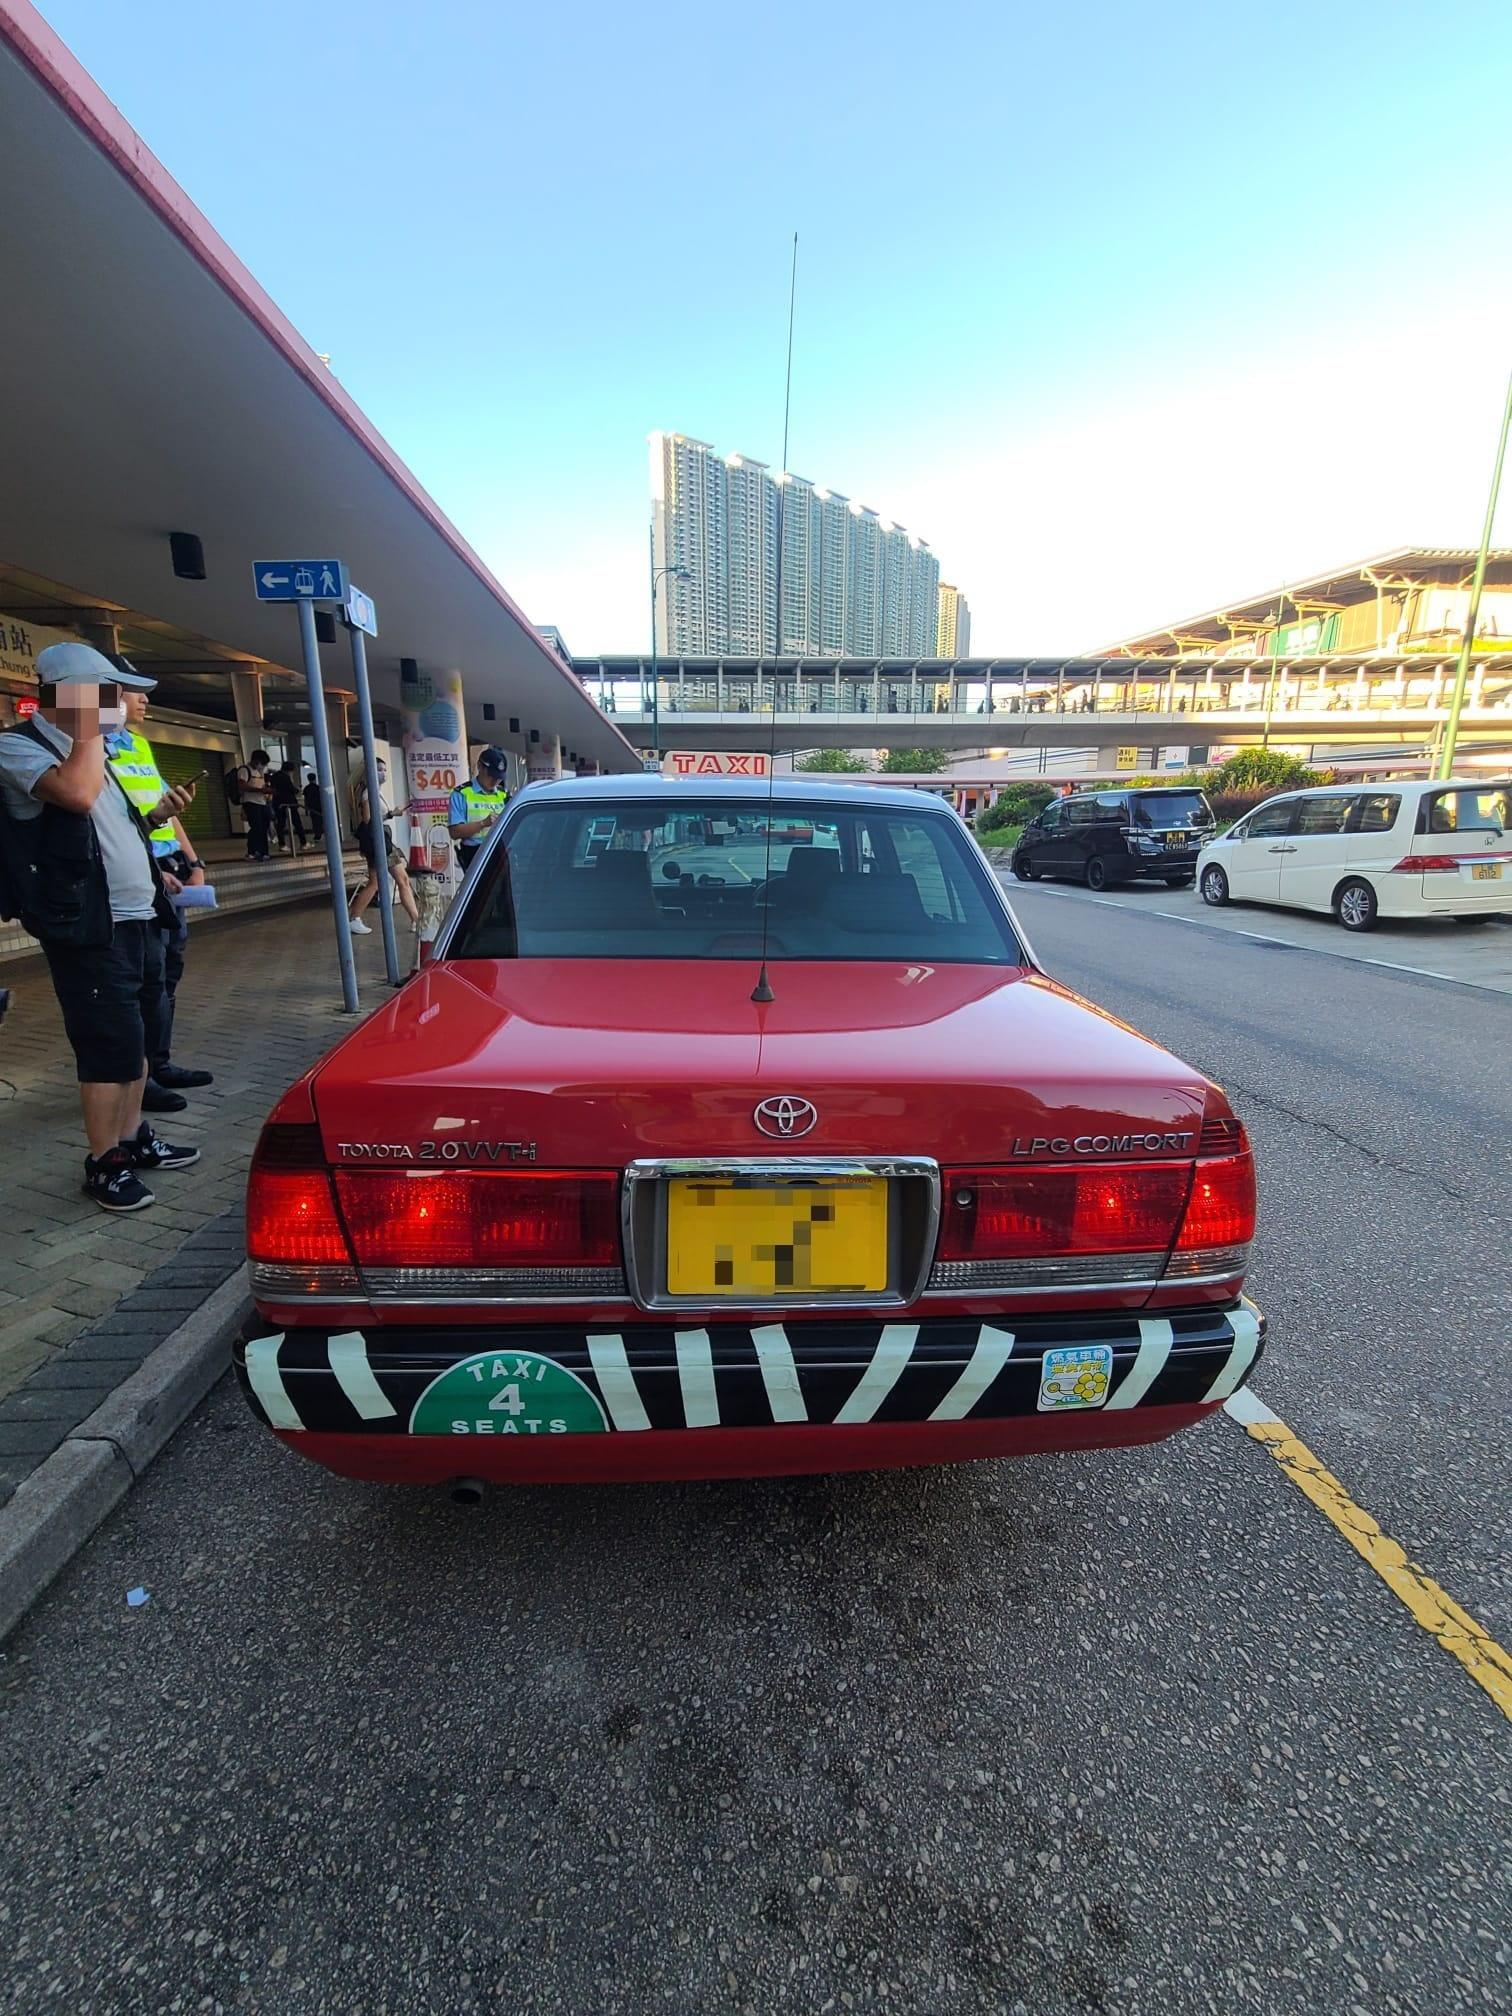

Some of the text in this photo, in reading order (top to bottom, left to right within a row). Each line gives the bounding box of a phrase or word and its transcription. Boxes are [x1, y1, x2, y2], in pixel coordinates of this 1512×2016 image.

[0, 656, 31, 678] hung
[672, 754, 765, 775] TAXI
[416, 768, 456, 790] $40
[338, 1142, 414, 1160] TOYOTA
[1074, 1132, 1194, 1153] COMFORT
[466, 1358, 547, 1382] TAXI
[488, 1383, 526, 1416] 4
[451, 1419, 568, 1434] SEATS
